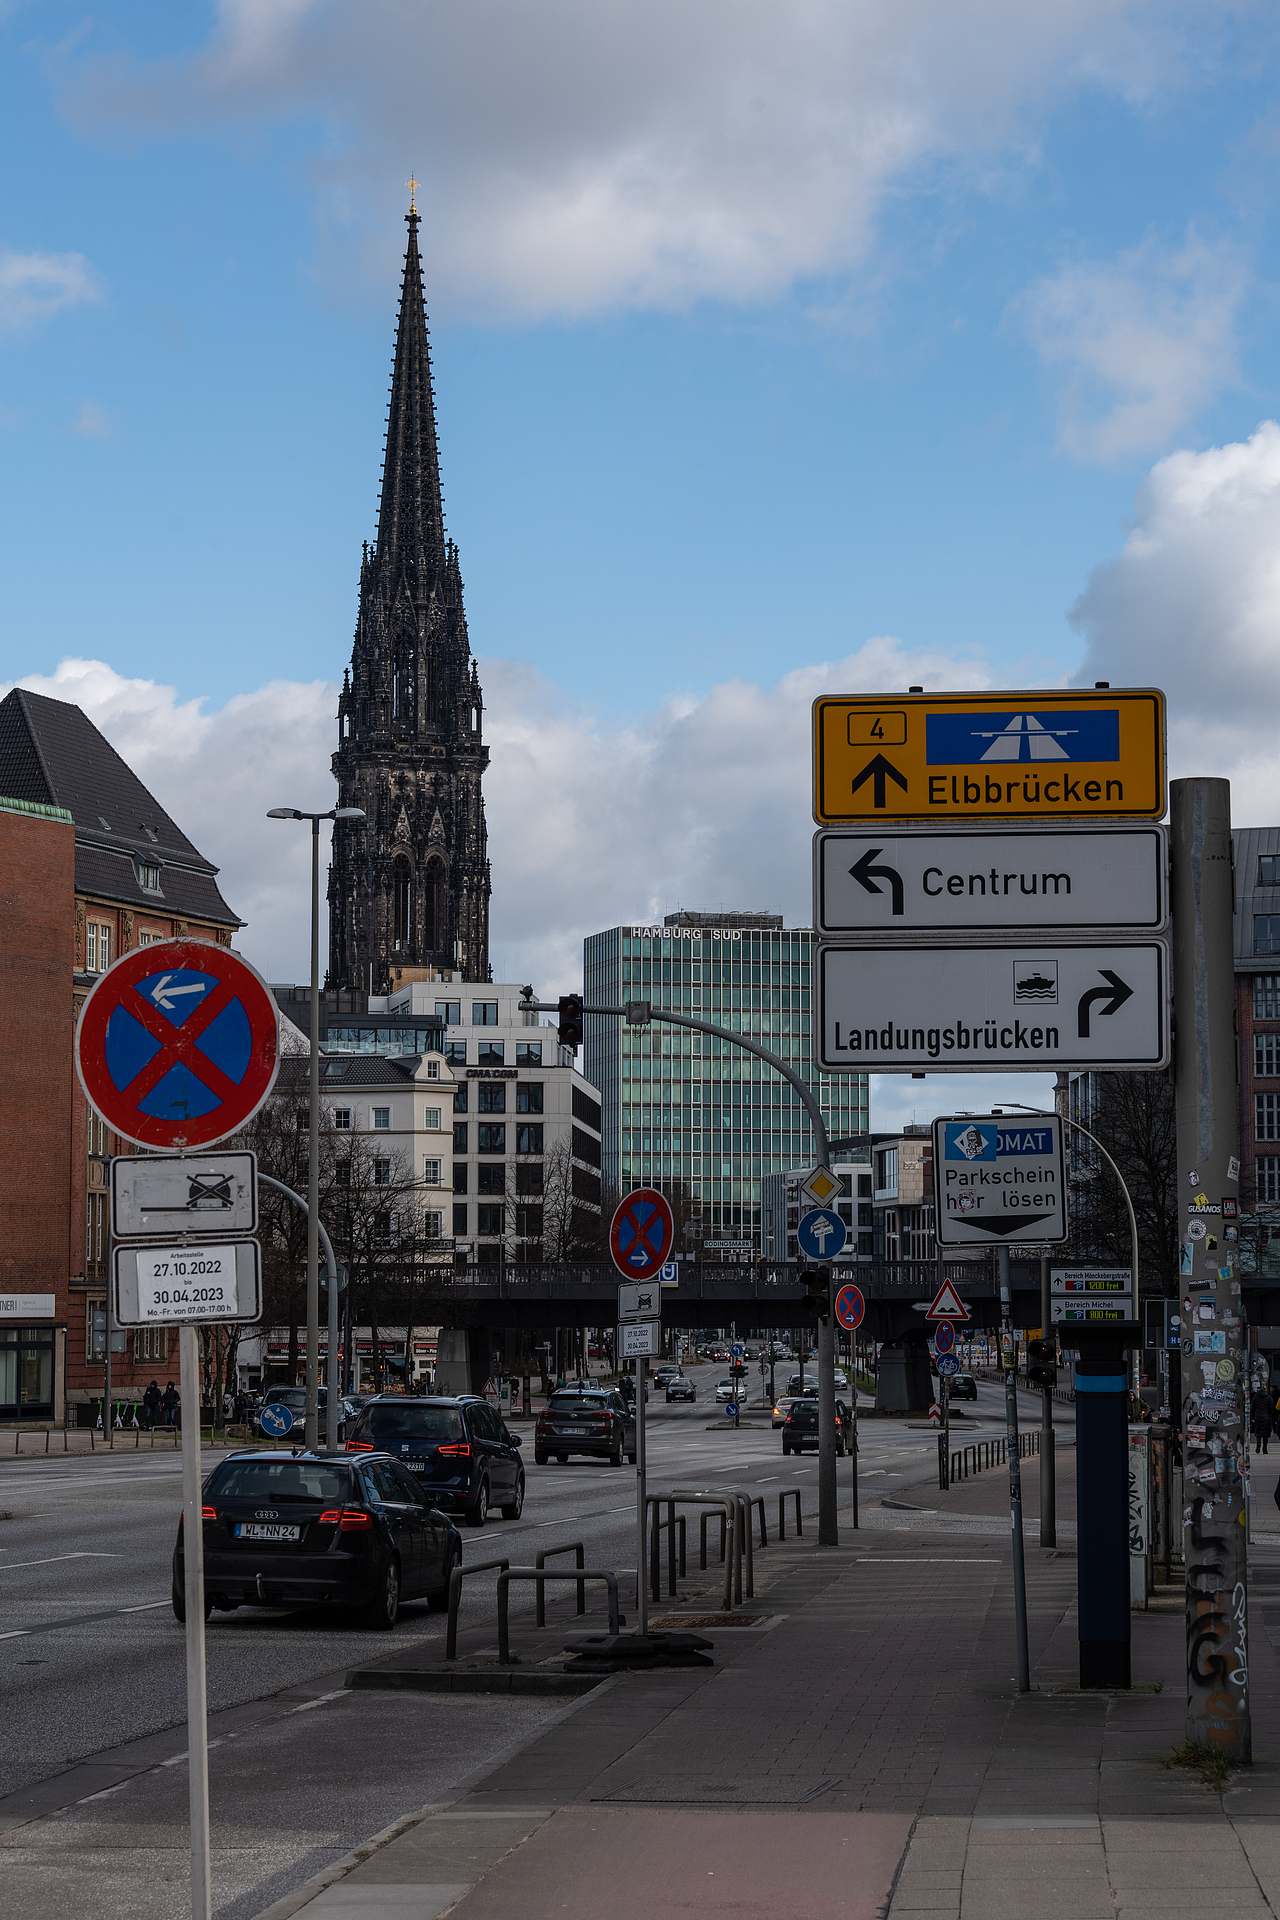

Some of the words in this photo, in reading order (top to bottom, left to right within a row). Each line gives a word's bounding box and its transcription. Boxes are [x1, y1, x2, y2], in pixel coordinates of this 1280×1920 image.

[870, 717, 884, 739] 4
[928, 773, 1123, 804] Elbbrücken
[922, 867, 1071, 896] Centrum
[632, 927, 701, 938] HAMBURG
[712, 929, 741, 940] SÜD
[835, 1020, 1059, 1057] Landungsbrücken
[466, 1069, 491, 1078] CMA
[492, 1069, 518, 1079] CGM
[997, 1132, 1046, 1152] OMAT
[945, 1166, 1055, 1186] Parkschein
[946, 1192, 985, 1210] hr
[1002, 1190, 1056, 1208] lösen
[1188, 1205, 1221, 1213] GUSANOS
[170, 1251, 204, 1259] Arbeitsstelle
[153, 1260, 222, 1277] 27.10.2022
[1088, 1281, 1104, 1290] 1200
[1106, 1282, 1119, 1290] frei
[153, 1288, 224, 1304] 30.04.2023
[0, 1300, 15, 1311] TNER
[1090, 1310, 1104, 1319] 800
[1105, 1311, 1118, 1319] frei
[245, 1525, 258, 1535] WL
[266, 1526, 280, 1536] NN
[282, 1526, 295, 1537] 24
